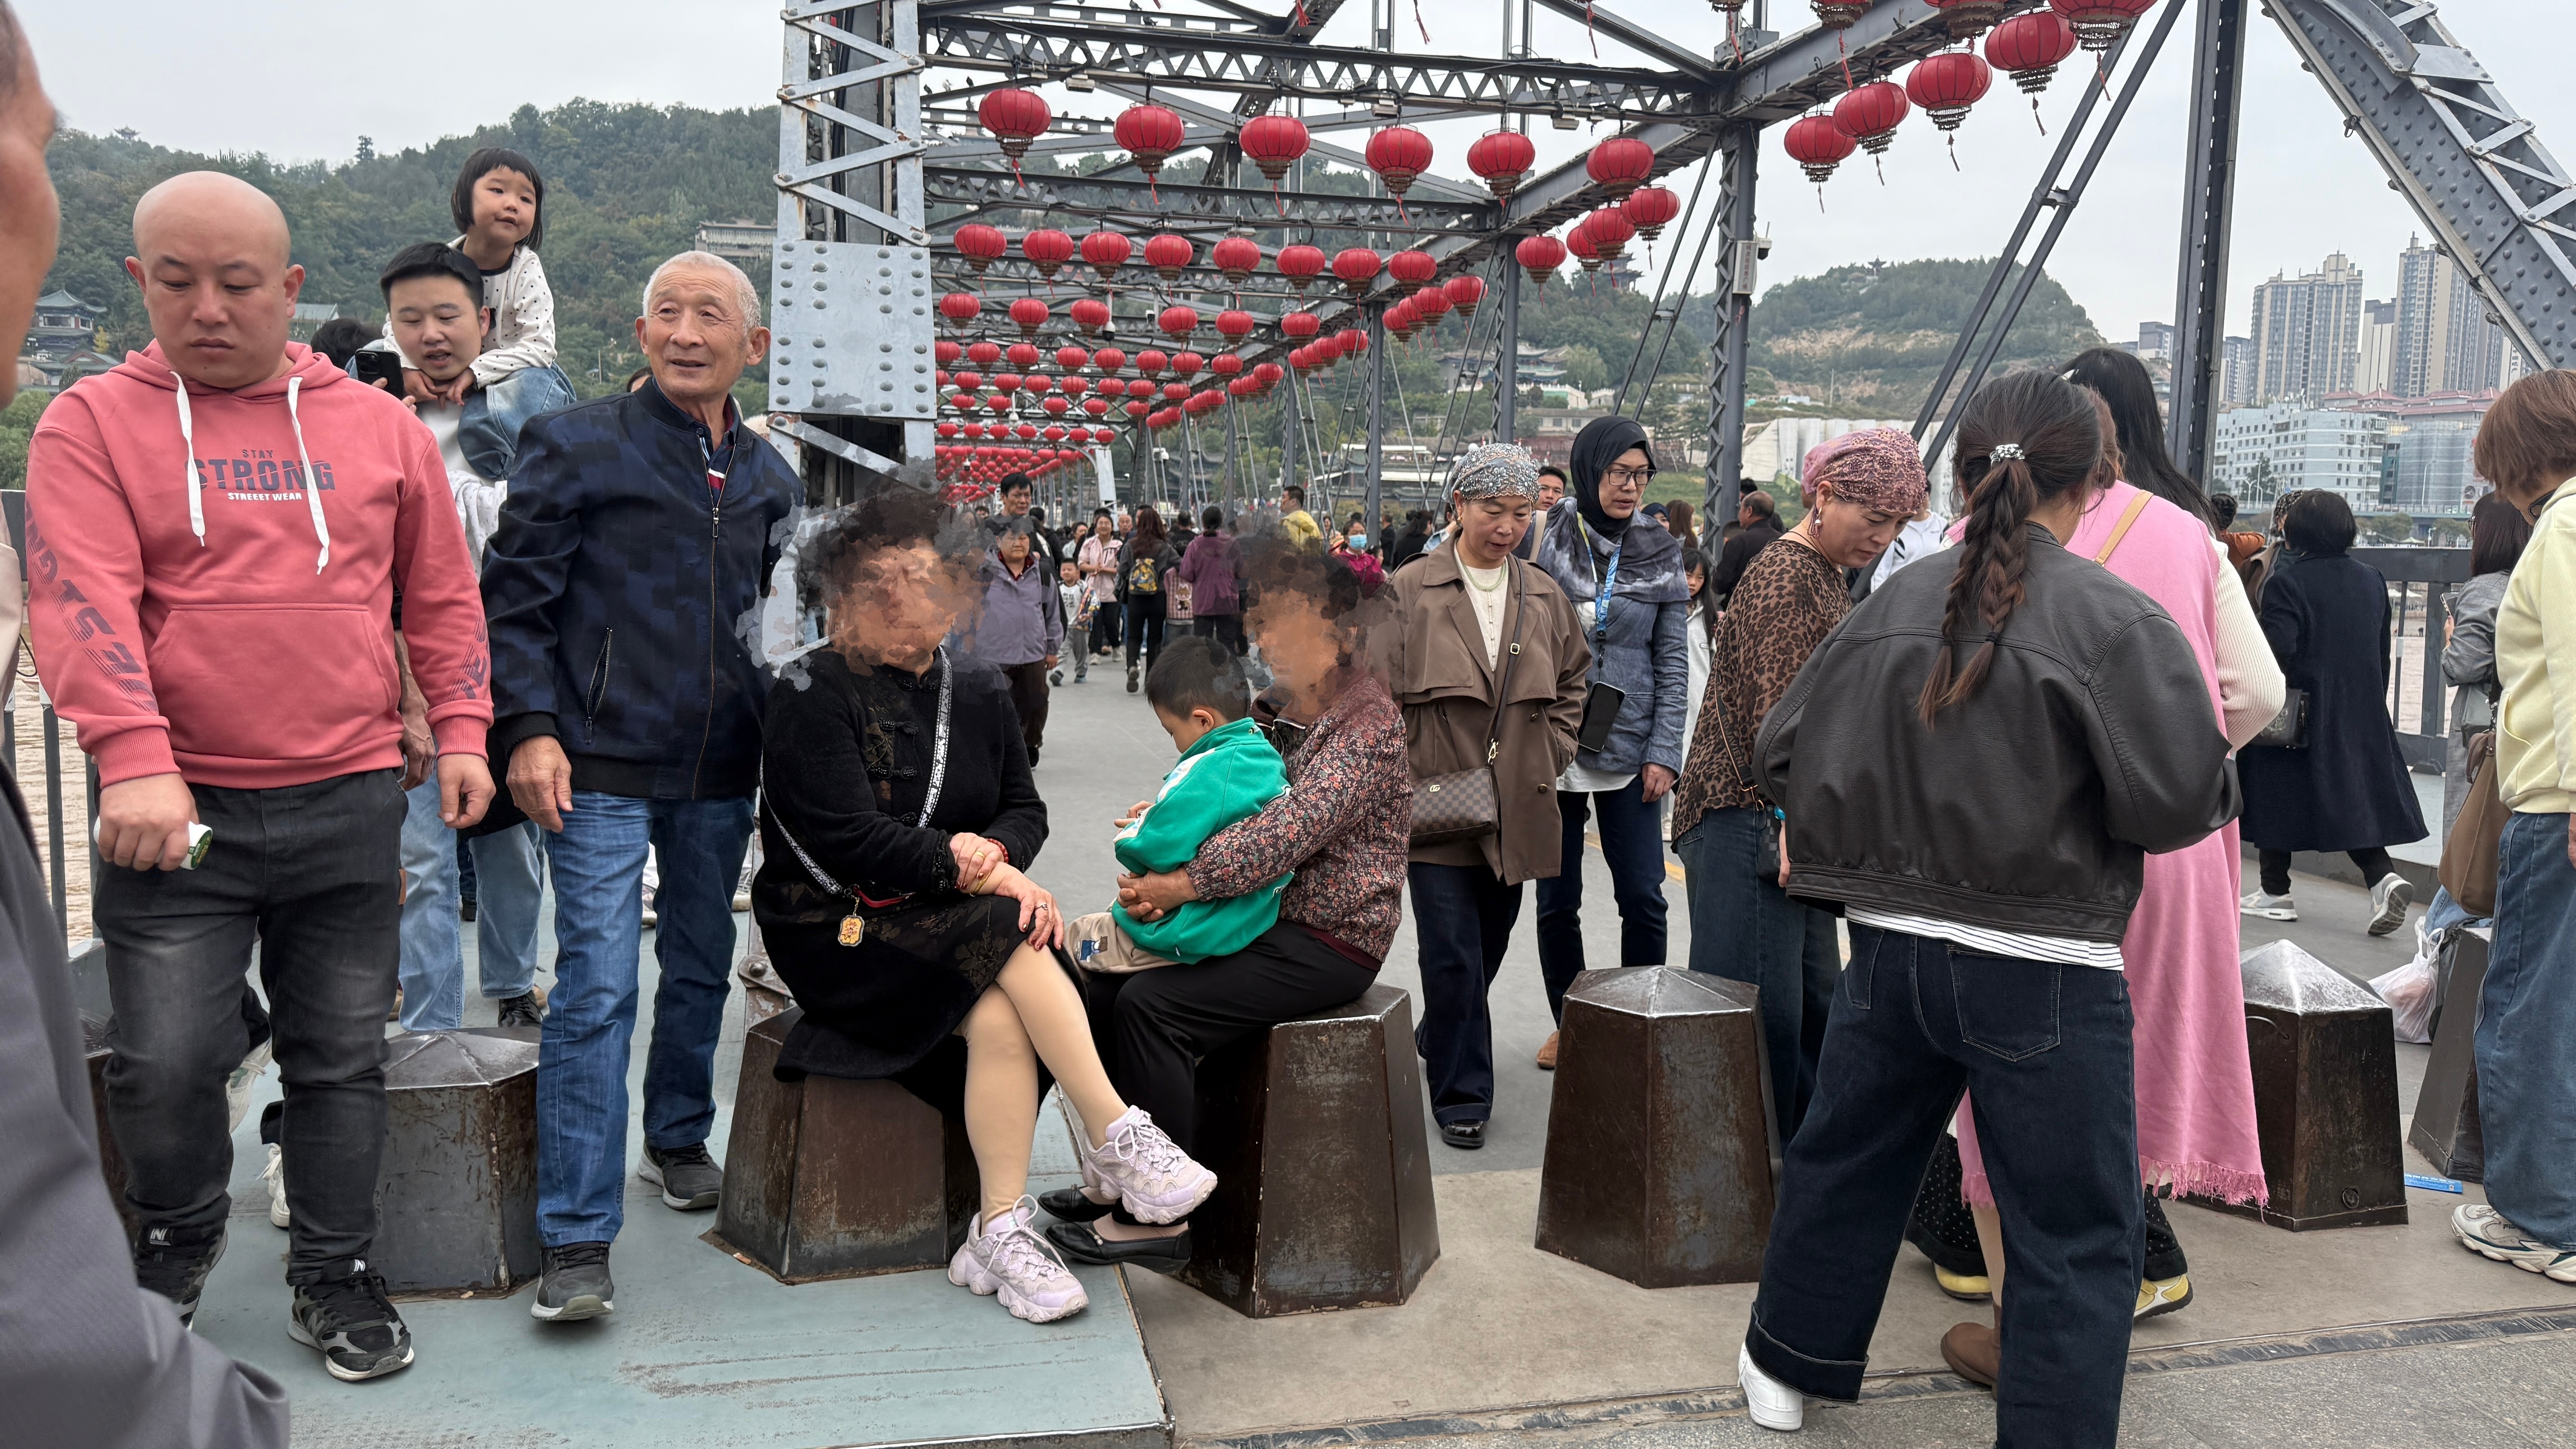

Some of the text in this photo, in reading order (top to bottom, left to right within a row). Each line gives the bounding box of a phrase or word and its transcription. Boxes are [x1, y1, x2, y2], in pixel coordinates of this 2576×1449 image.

[242, 449, 273, 458] STAY
[227, 492, 302, 501] STREEET WEAR
